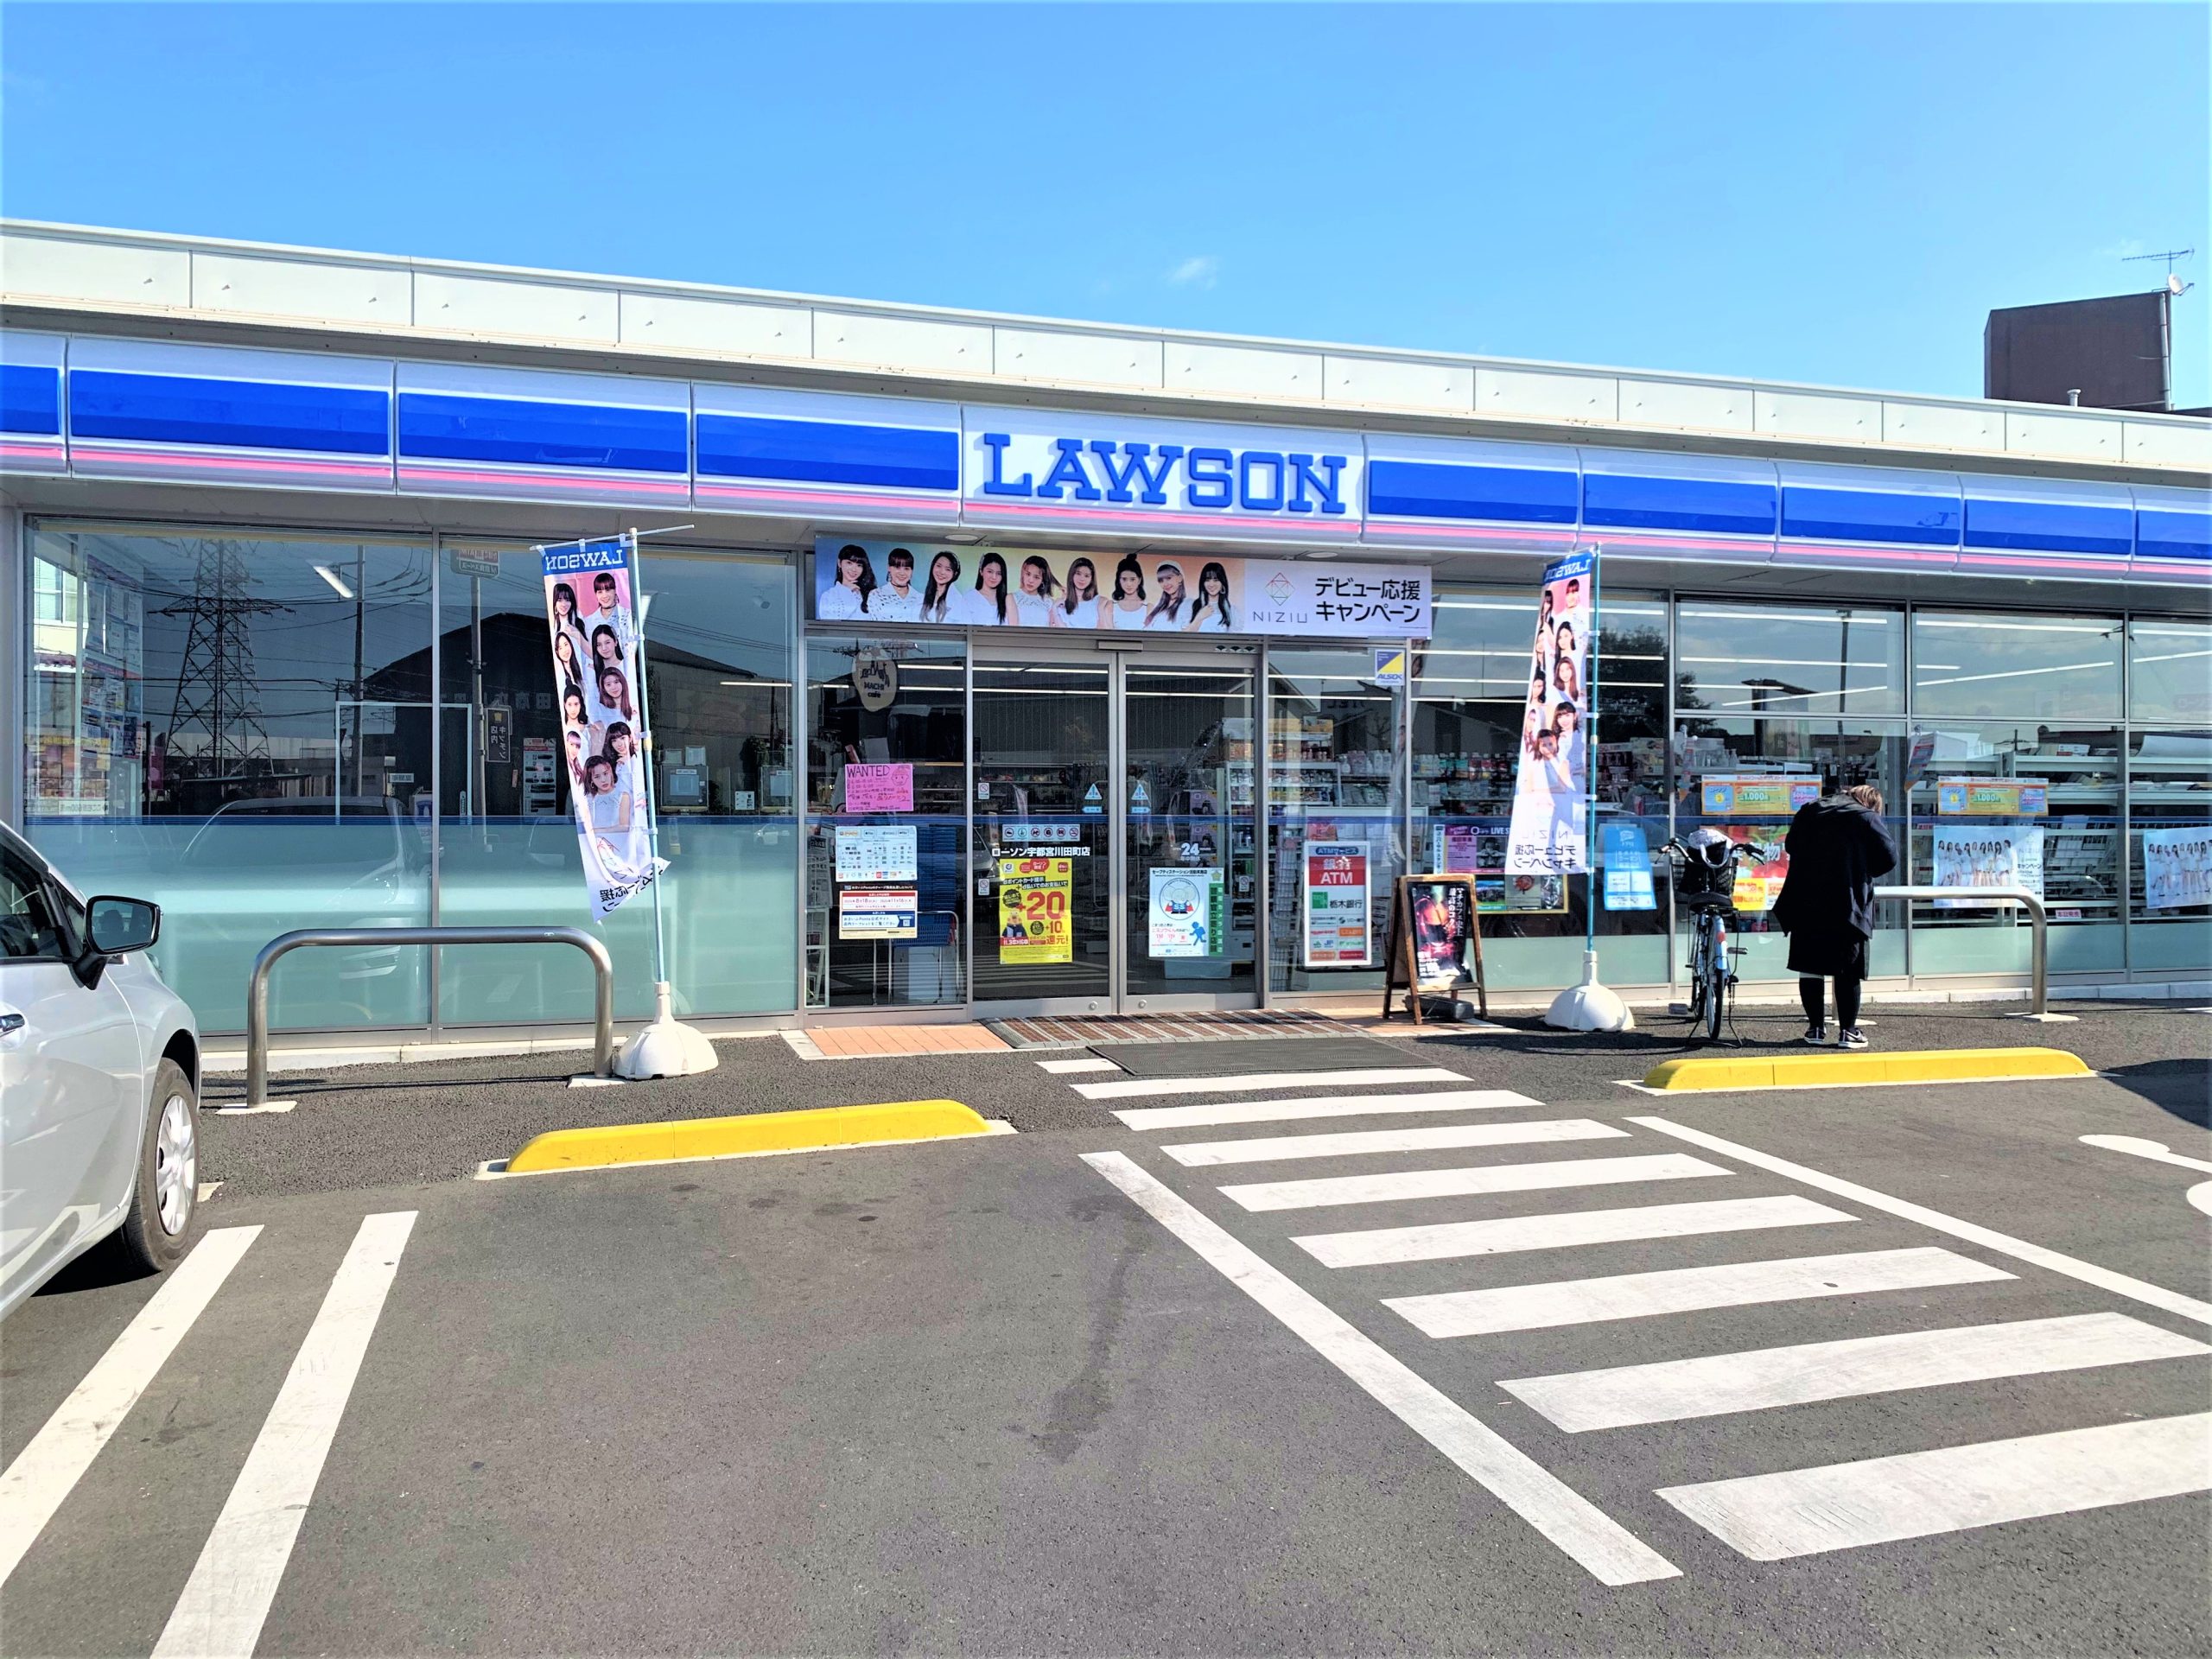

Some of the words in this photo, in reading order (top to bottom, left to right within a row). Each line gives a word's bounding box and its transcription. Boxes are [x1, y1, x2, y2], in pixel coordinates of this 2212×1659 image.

[983, 432, 1347, 513] LAWSON
[1315, 577, 1421, 601] デビュー応援
[1253, 611, 1307, 624] NIZIU
[1316, 601, 1421, 623] キャンペーン
[847, 765, 891, 778] WANTED
[991, 847, 1090, 857] ローソン宇都宮川田町店
[1180, 842, 1200, 856] 24
[1319, 871, 1353, 884] ATM
[1329, 899, 1363, 909] 栃木銀行
